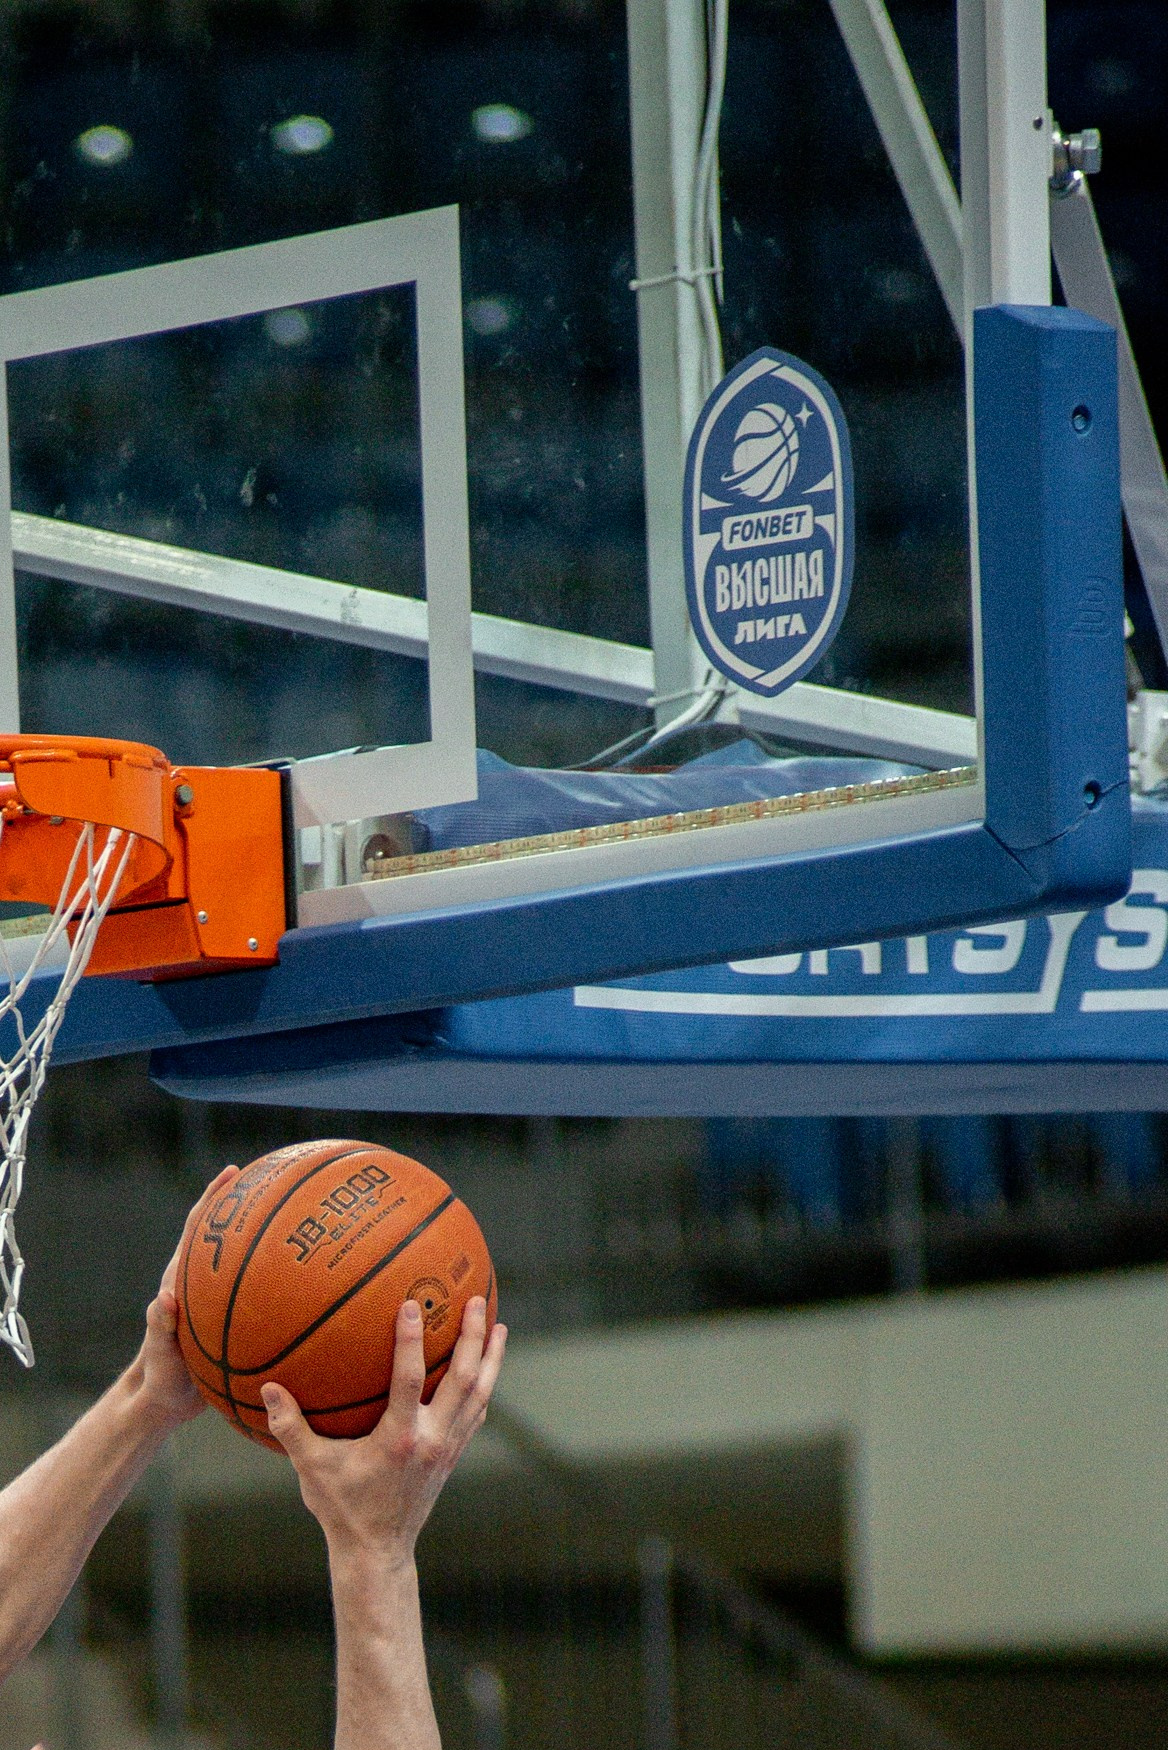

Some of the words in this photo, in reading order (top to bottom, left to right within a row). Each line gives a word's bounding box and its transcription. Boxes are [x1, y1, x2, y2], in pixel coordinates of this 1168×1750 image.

[729, 510, 807, 544] FONBET
[715, 549, 825, 613] ВЫСШАЯ
[734, 612, 808, 645] ЛИГА
[286, 1164, 391, 1262] JB-1000
[330, 1196, 379, 1241] ELITE
